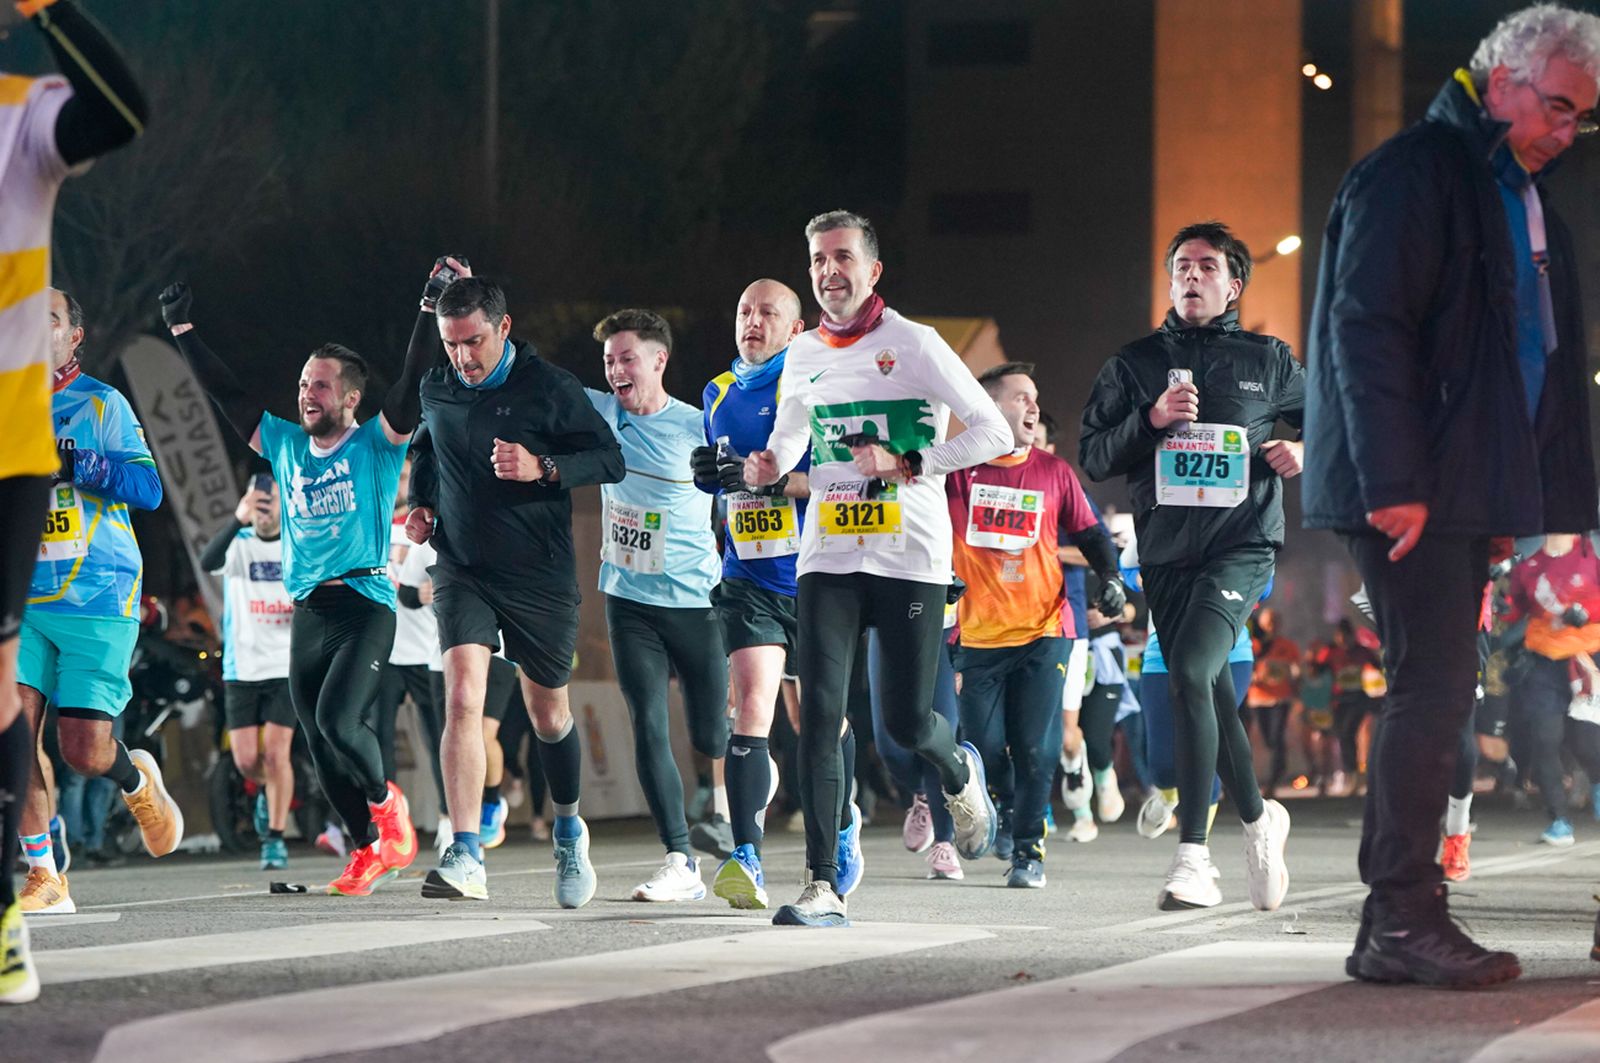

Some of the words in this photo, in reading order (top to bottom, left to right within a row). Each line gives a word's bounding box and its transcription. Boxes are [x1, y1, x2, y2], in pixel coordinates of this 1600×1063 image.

[1238, 380, 1264, 393] NASA
[173, 378, 237, 520] PEMASA
[1166, 441, 1184, 450] SAN
[1174, 452, 1230, 479] 8275
[825, 493, 841, 502] SAN
[836, 483, 860, 491] NOCHE
[735, 509, 783, 534] 8563
[835, 503, 884, 527] 3121
[611, 523, 651, 551] 6328
